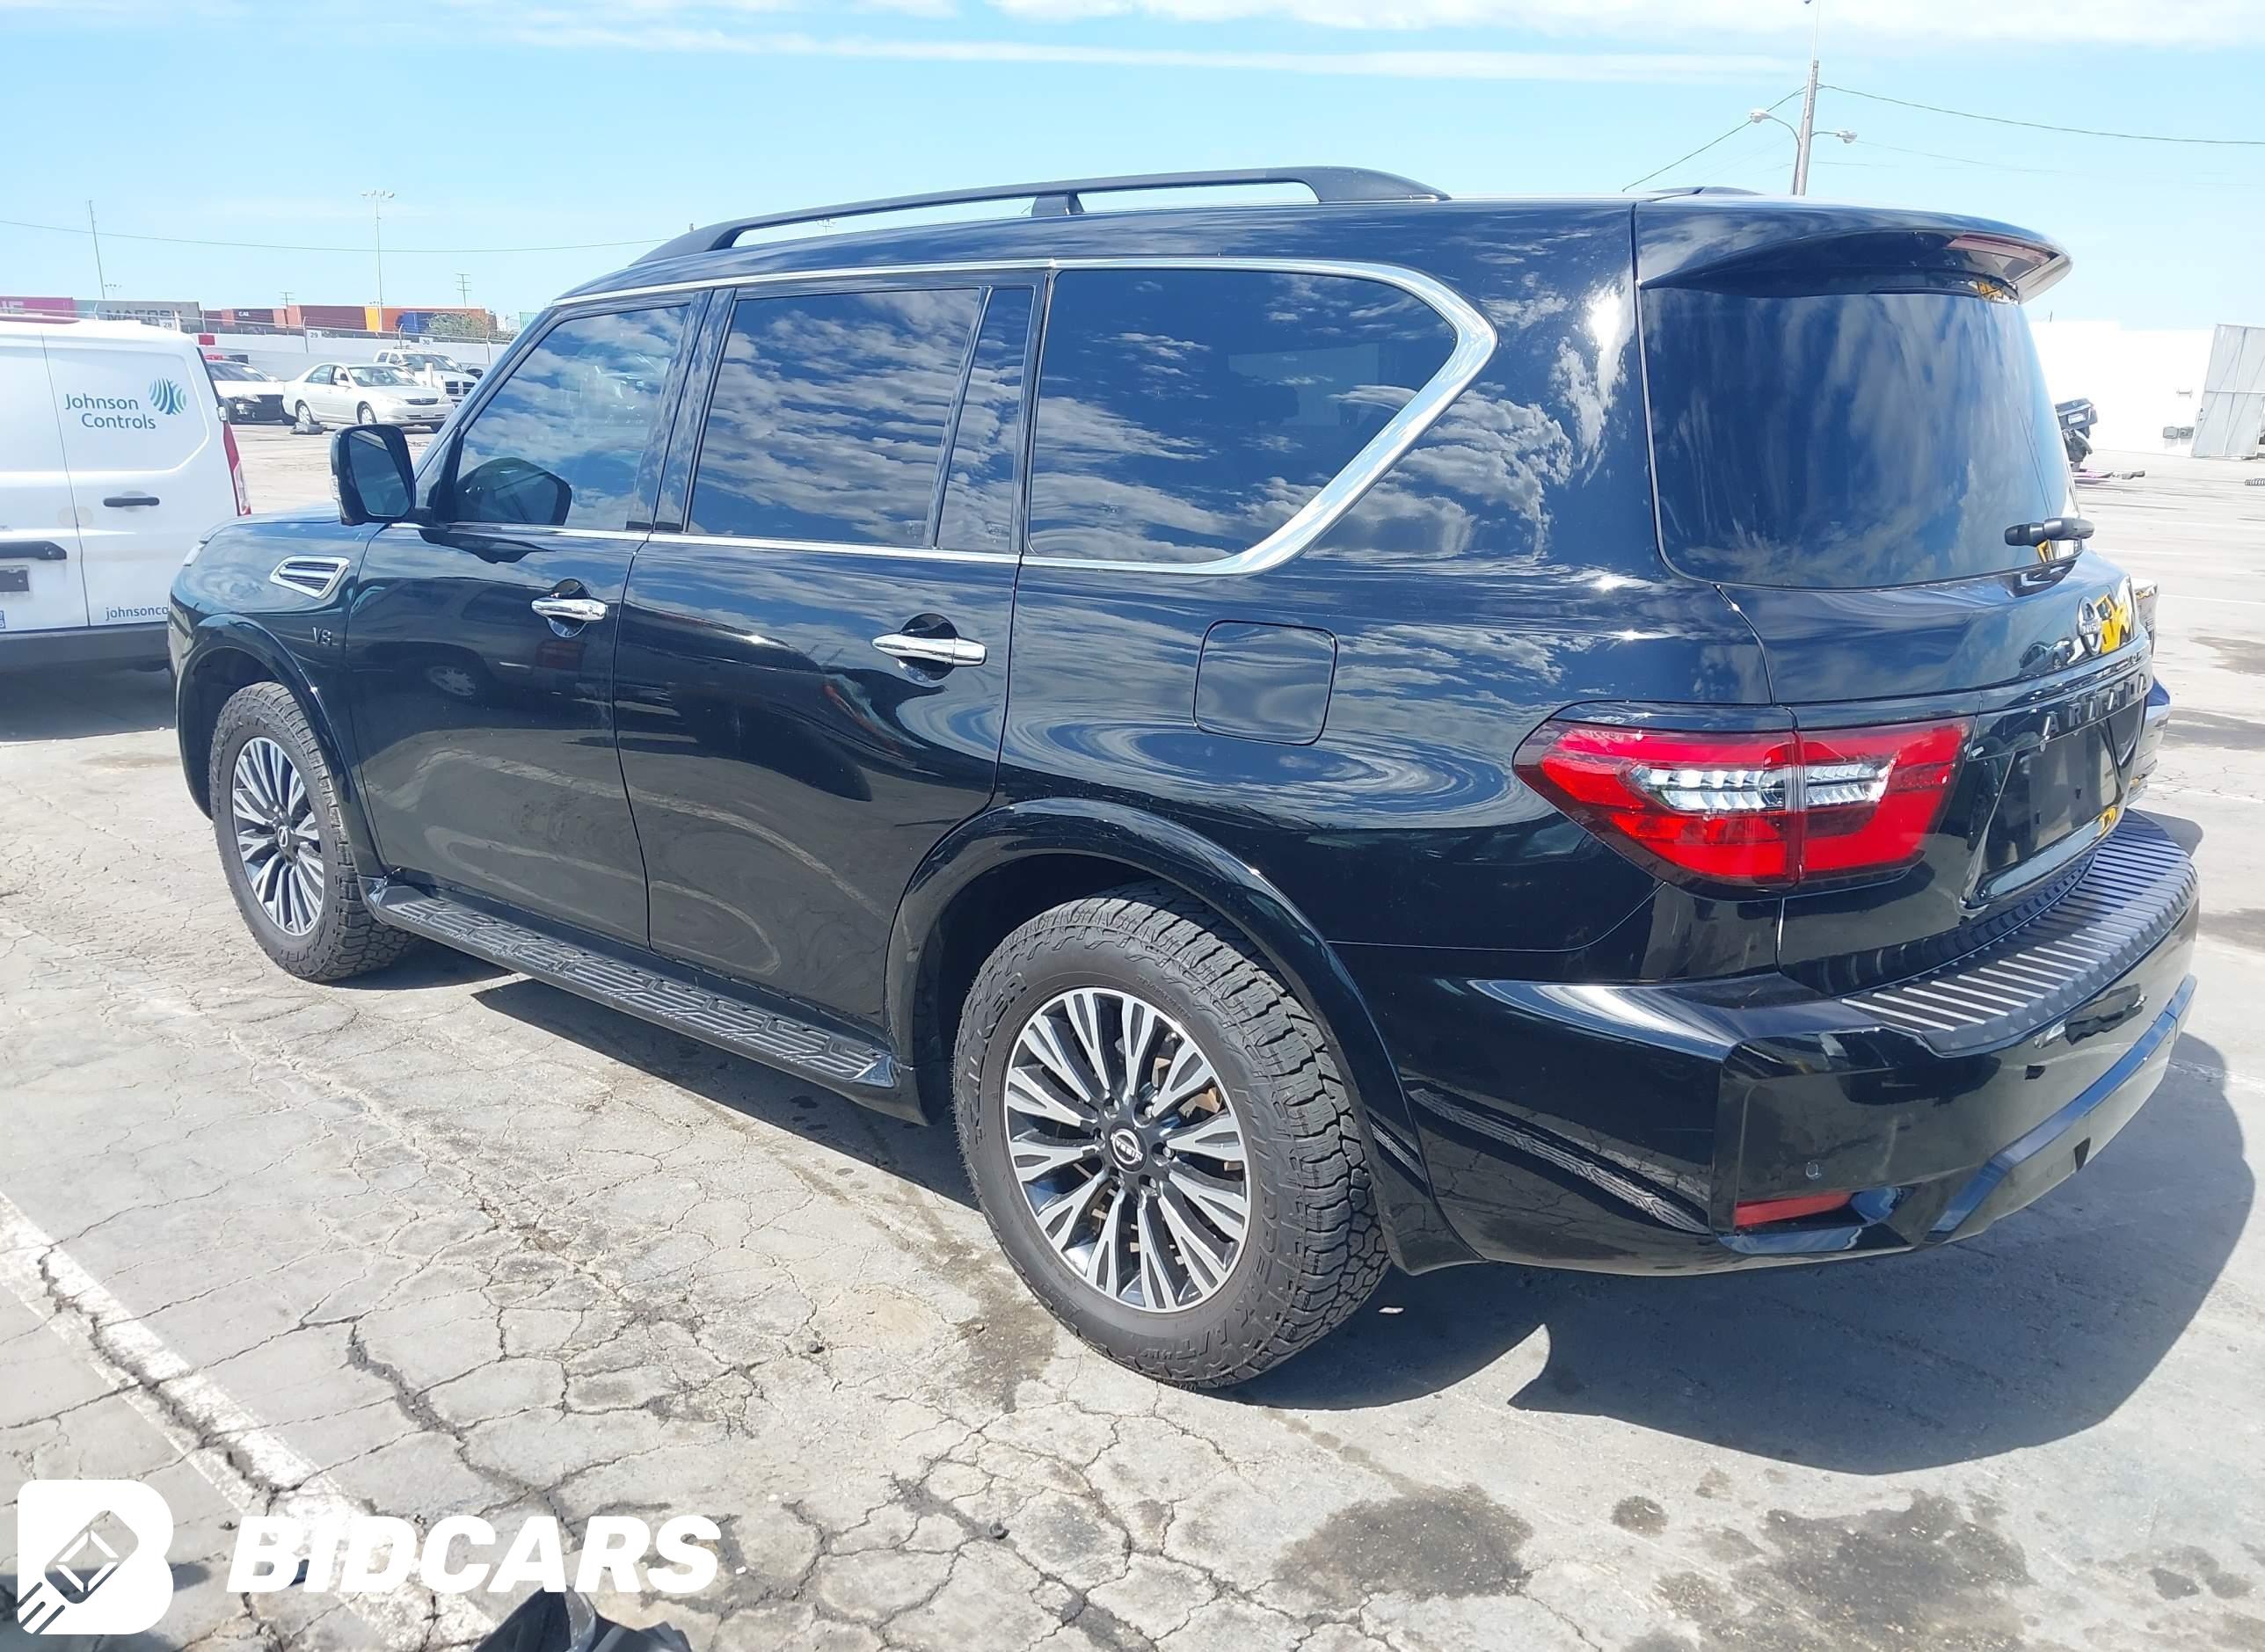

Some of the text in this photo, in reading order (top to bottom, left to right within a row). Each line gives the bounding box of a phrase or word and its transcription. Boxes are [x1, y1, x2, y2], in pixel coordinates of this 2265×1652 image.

[65, 393, 139, 411] Johnson
[81, 412, 157, 429] Controls
[312, 626, 331, 647] V8
[2042, 673, 2147, 737] ARMADA
